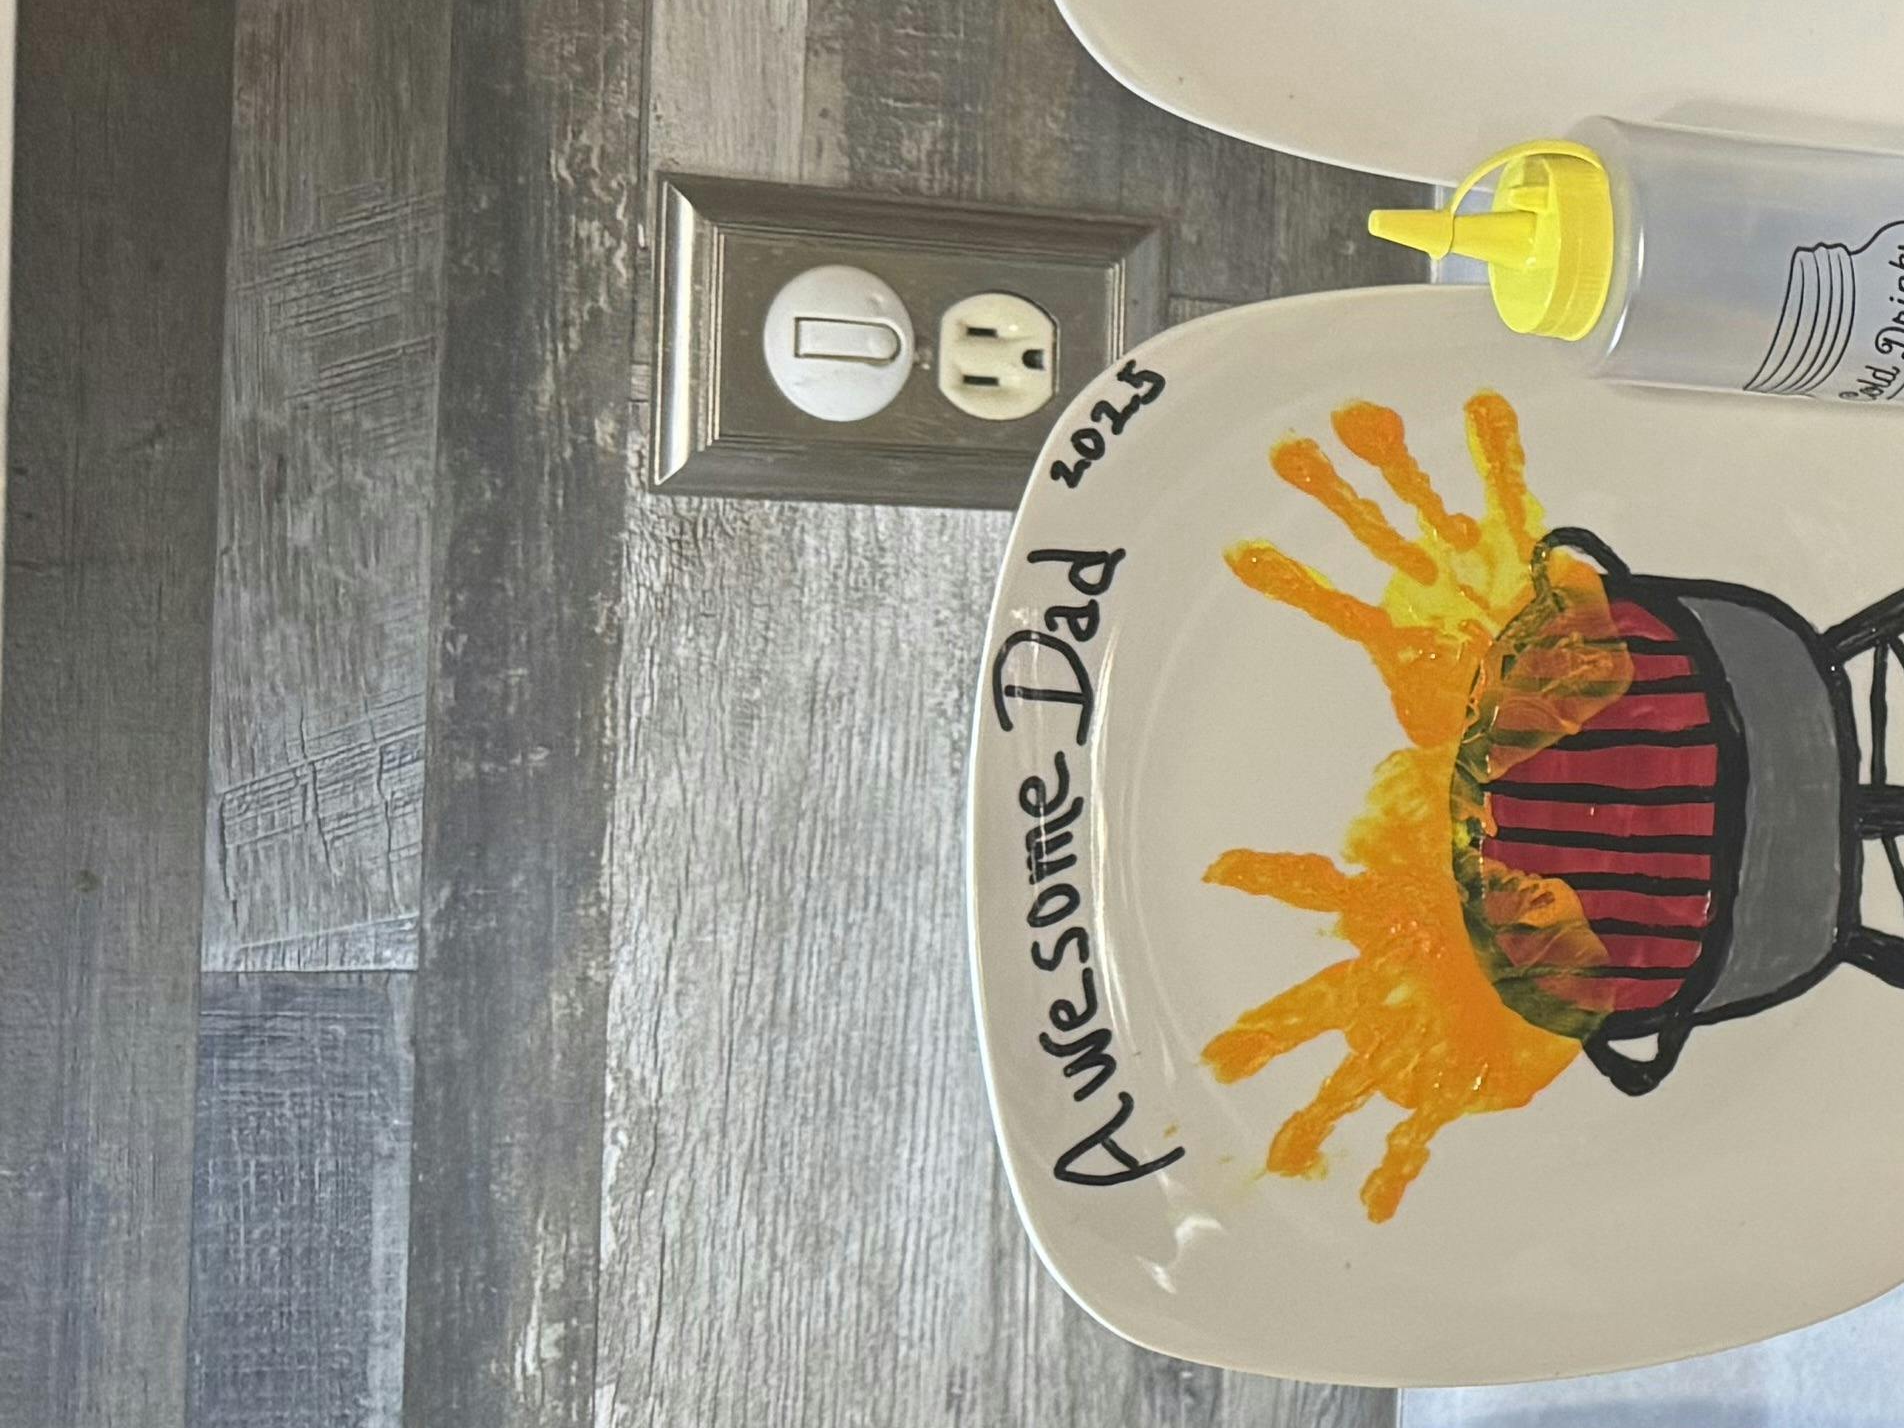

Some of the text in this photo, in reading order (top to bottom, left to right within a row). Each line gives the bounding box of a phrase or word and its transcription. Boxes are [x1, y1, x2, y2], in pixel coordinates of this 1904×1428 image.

[992, 359, 1185, 1187] Awesome Dad 2025
